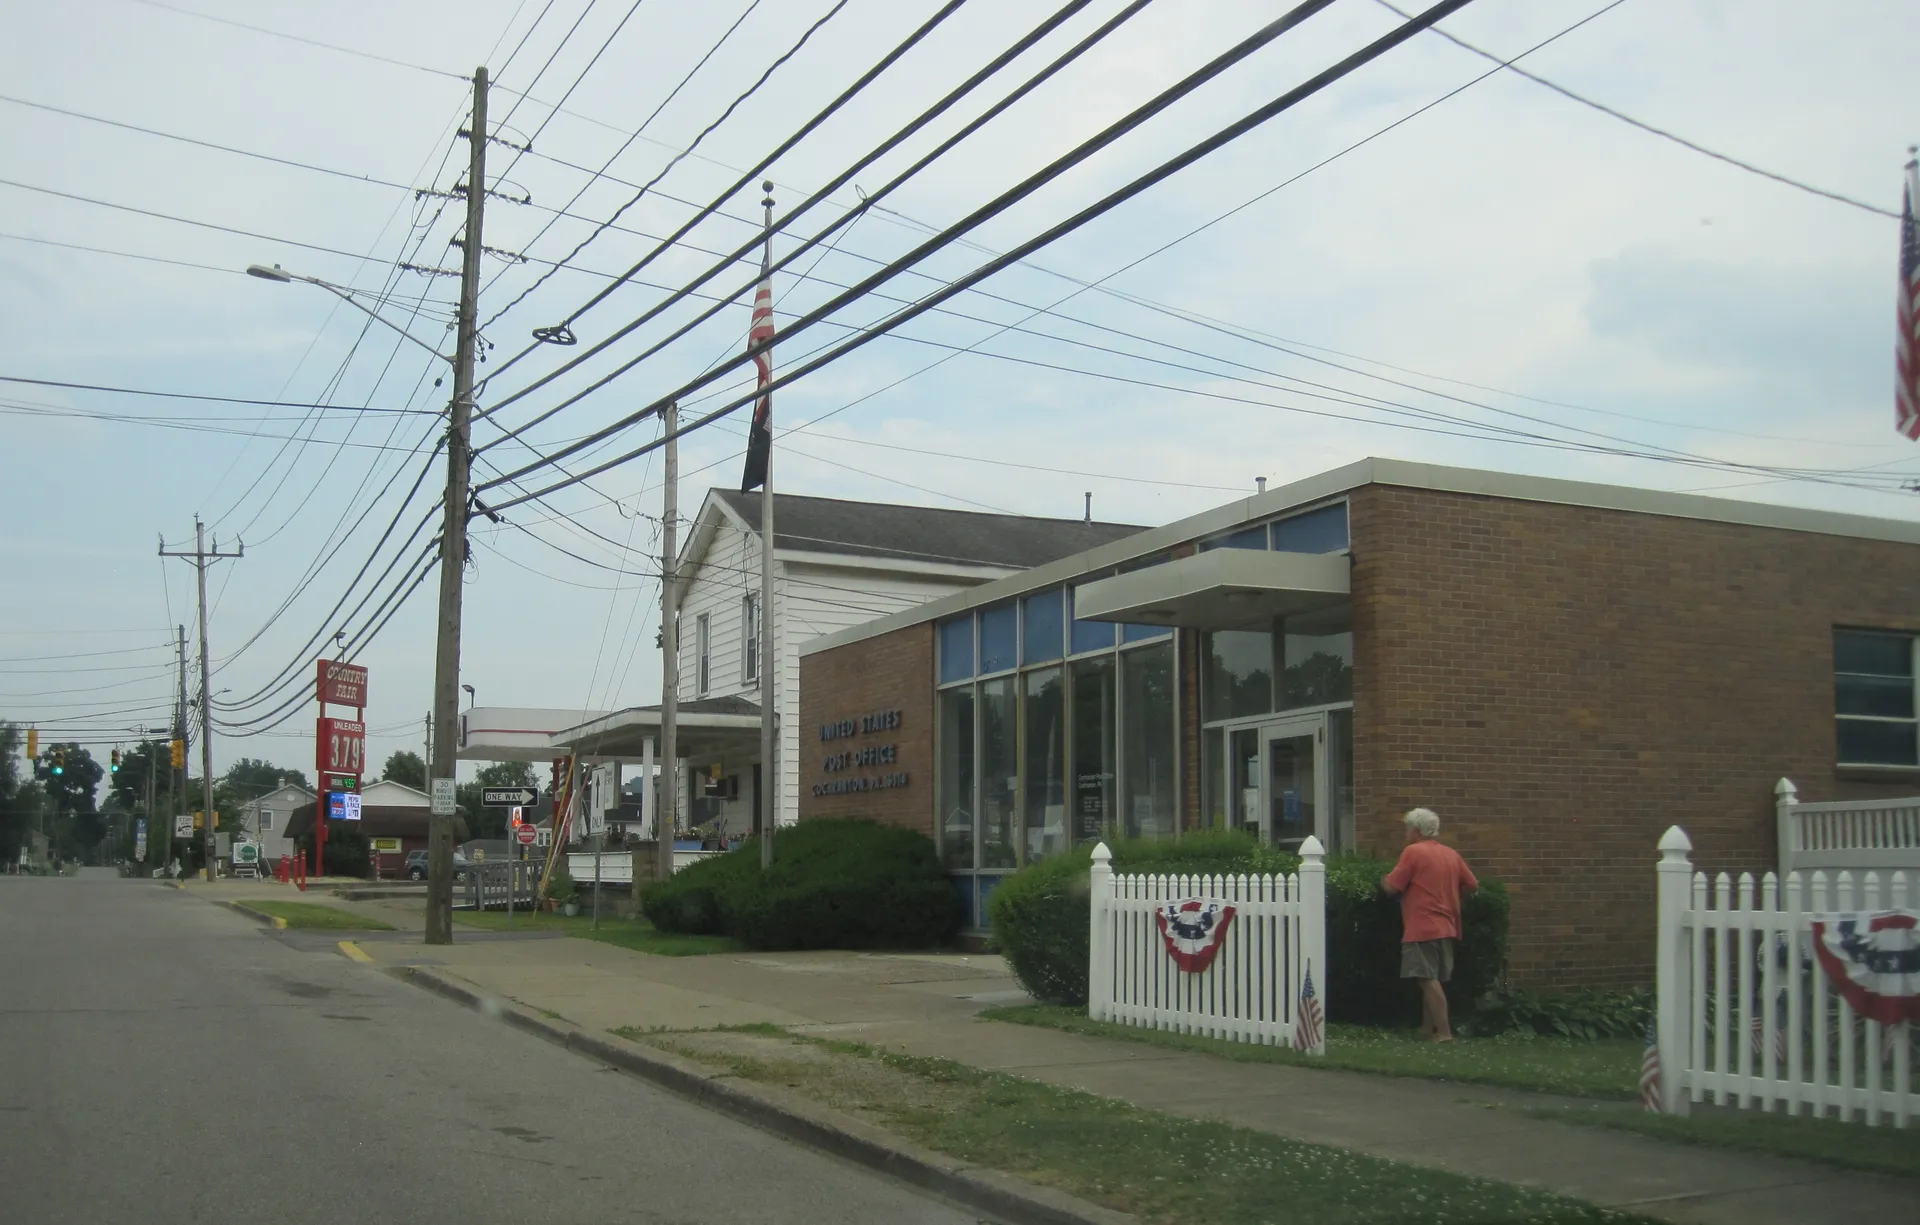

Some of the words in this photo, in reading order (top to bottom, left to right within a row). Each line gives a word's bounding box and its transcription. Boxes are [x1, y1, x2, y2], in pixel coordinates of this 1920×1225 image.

[327, 666, 367, 685] COUNTRY
[336, 684, 358, 700] FAIR
[334, 720, 363, 733] UNLEADED
[819, 720, 855, 741] UNITED
[860, 709, 901, 733] STATES
[822, 752, 850, 772] POST
[855, 746, 895, 767] OFFICE
[440, 780, 449, 788] 30
[486, 793, 502, 801] ONE
[505, 793, 522, 801] WAY
[592, 815, 603, 829] ONLY
